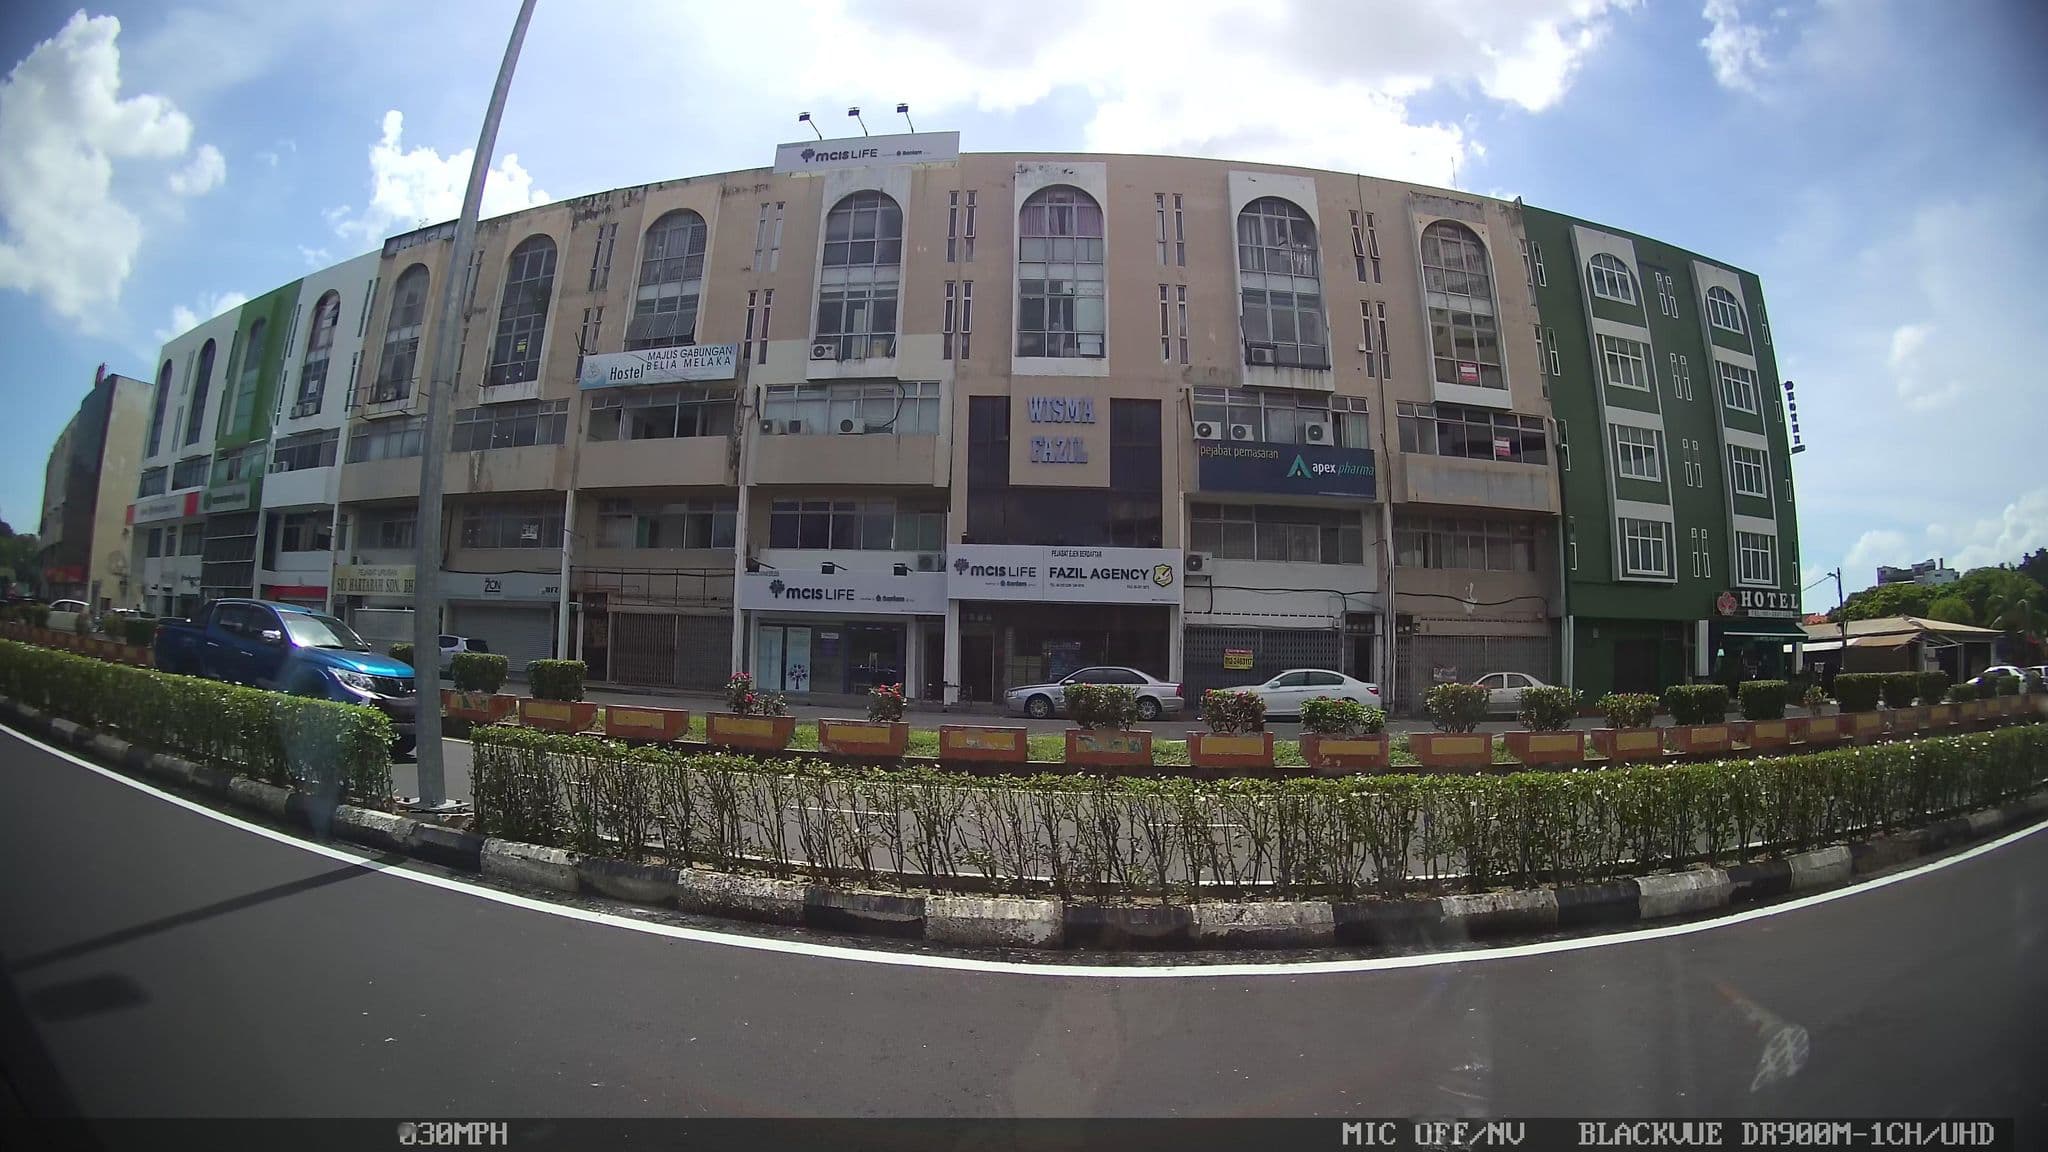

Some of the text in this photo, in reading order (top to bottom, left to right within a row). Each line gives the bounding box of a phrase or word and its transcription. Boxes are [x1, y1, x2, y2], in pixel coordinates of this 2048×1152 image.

[851, 149, 878, 159] LIFE
[648, 346, 733, 361] MAJLIS GABUNGAN
[646, 356, 731, 371] BELIA MELAKA
[610, 364, 645, 381] Hostel
[1026, 396, 1096, 424] WISMA
[1031, 436, 1088, 464] FAZIL
[1200, 444, 1279, 461] pejabat pemasaran
[1312, 462, 1374, 476] apex pharma
[1008, 567, 1037, 577] LIFE
[1050, 567, 1149, 580] FAZIL AGENCY
[825, 589, 855, 600] LIFE
[1741, 590, 1799, 609] HOTEL
